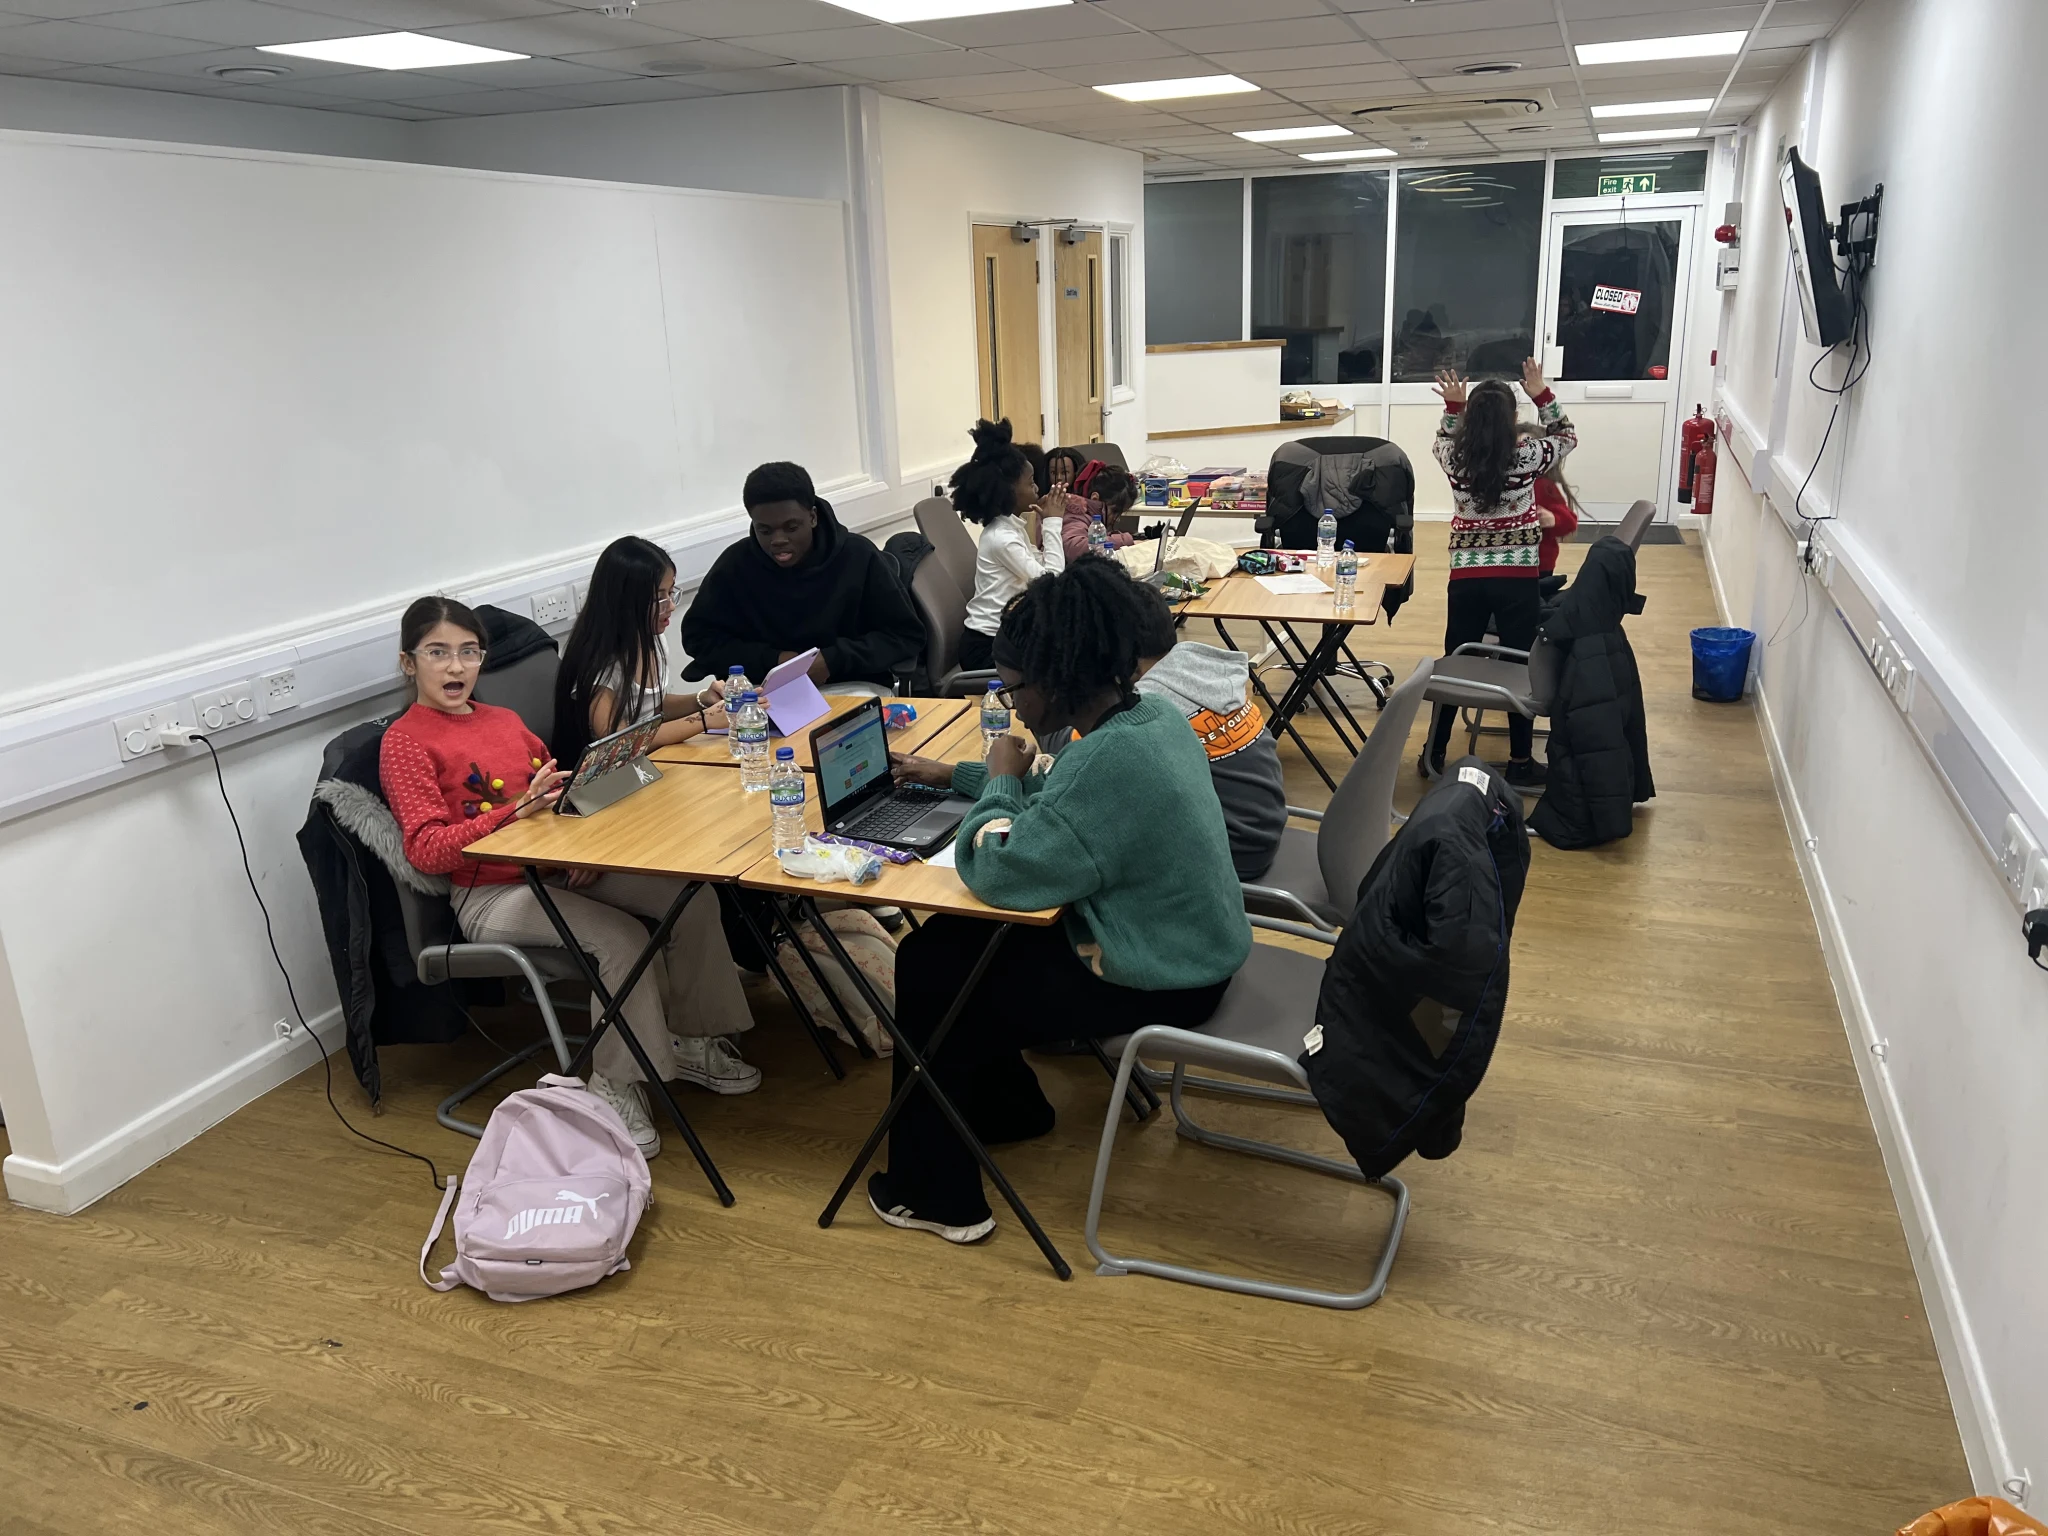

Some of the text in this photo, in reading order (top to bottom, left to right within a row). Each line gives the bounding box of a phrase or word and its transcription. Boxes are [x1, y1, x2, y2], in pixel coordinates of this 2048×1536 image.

[1603, 178, 1617, 186] Fire
[1595, 288, 1623, 303] CLOSED
[1219, 715, 1241, 733] YOU
[774, 793, 802, 803] BUXTON
[503, 1205, 584, 1240] PUMA
